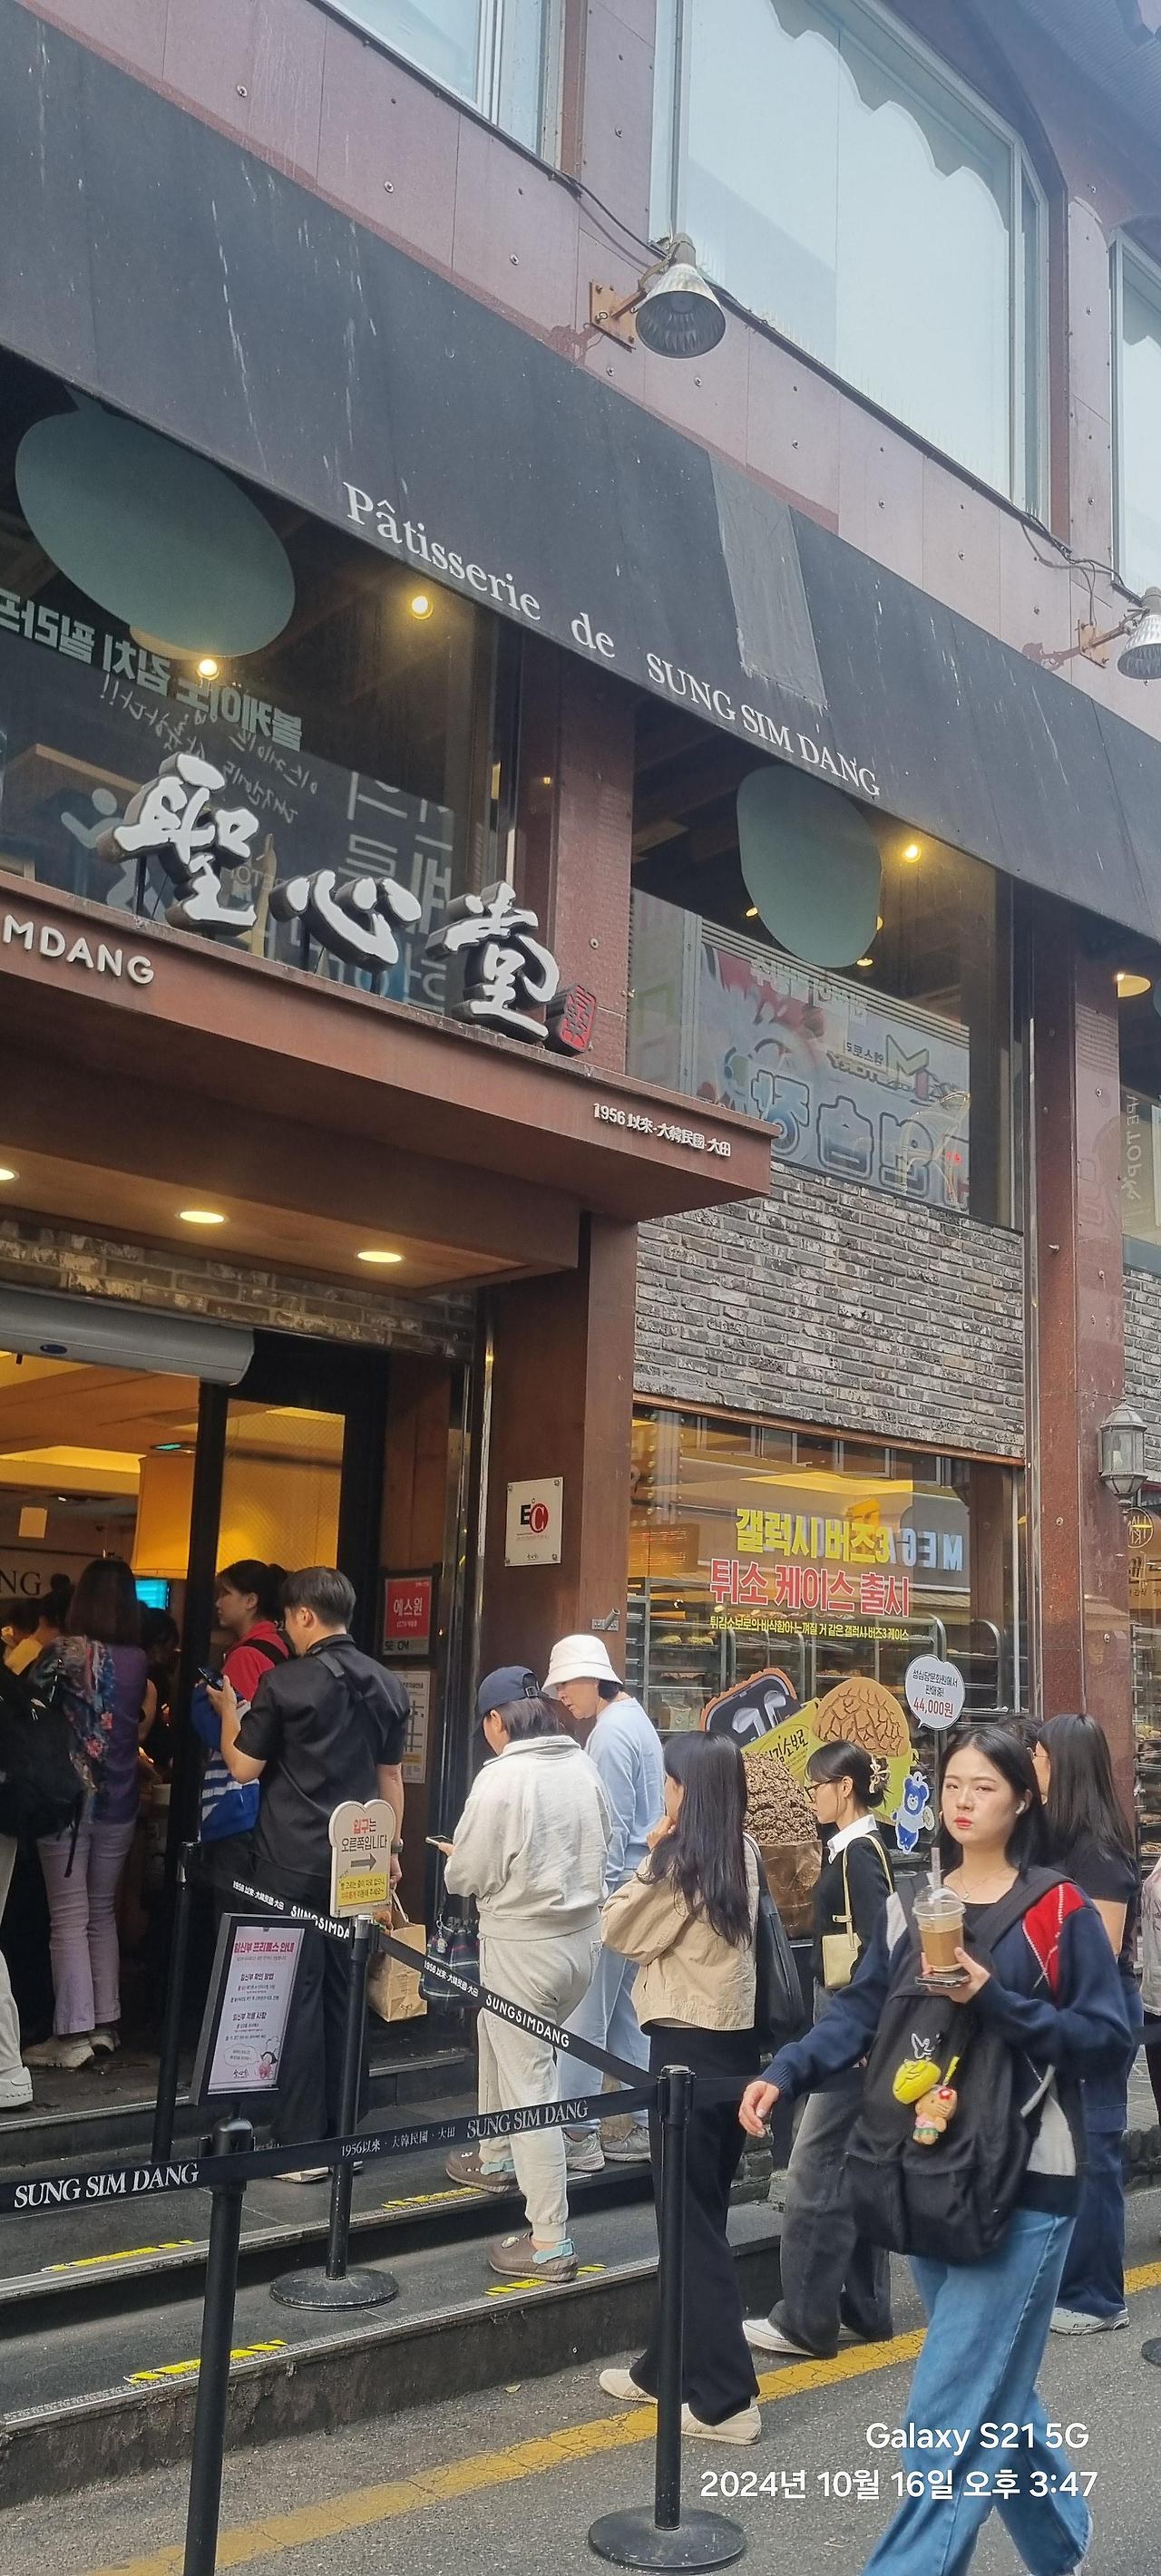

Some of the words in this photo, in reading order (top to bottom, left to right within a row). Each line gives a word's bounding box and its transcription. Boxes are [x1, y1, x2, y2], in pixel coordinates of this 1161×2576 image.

[343, 482, 541, 619] Pâtisserie
[571, 612, 615, 658] de
[647, 652, 736, 722] SUNG
[741, 705, 791, 753] SIM
[799, 733, 880, 798] DANG
[114, 753, 560, 1040] 聖心堂
[3, 914, 154, 985] MDANG
[593, 1103, 626, 1125] 1956
[736, 1508, 817, 1560] 갤럭시
[824, 1519, 890, 1564] 버즈3
[710, 1558, 768, 1606] 튀소
[775, 1564, 854, 1612] 케이스
[860, 1571, 910, 1618] 출시
[393, 1597, 424, 1617] 에스원
[819, 1624, 827, 1636] 거
[828, 1624, 844, 1637] 같은
[844, 1625, 866, 1638] 갤럭시
[868, 1627, 887, 1639] 버즈3
[888, 1628, 909, 1641] 케이스
[912, 1669, 958, 1687] 성심당문화원에서
[913, 1697, 954, 1718] 44,000원
[353, 1818, 376, 1834] 입구는
[341, 1834, 387, 1852] 오른쪽입니다
[234, 1942, 253, 1953] 임신부
[279, 1941, 295, 1953] 안내
[485, 1994, 571, 2048] SUNGSIMDANG
[466, 2115, 511, 2139] SUNG
[513, 2108, 541, 2131] SIM
[543, 2100, 590, 2124] DANG
[14, 2178, 82, 2209] SUNG
[85, 2171, 127, 2199] SIM
[132, 2163, 199, 2192] DANG
